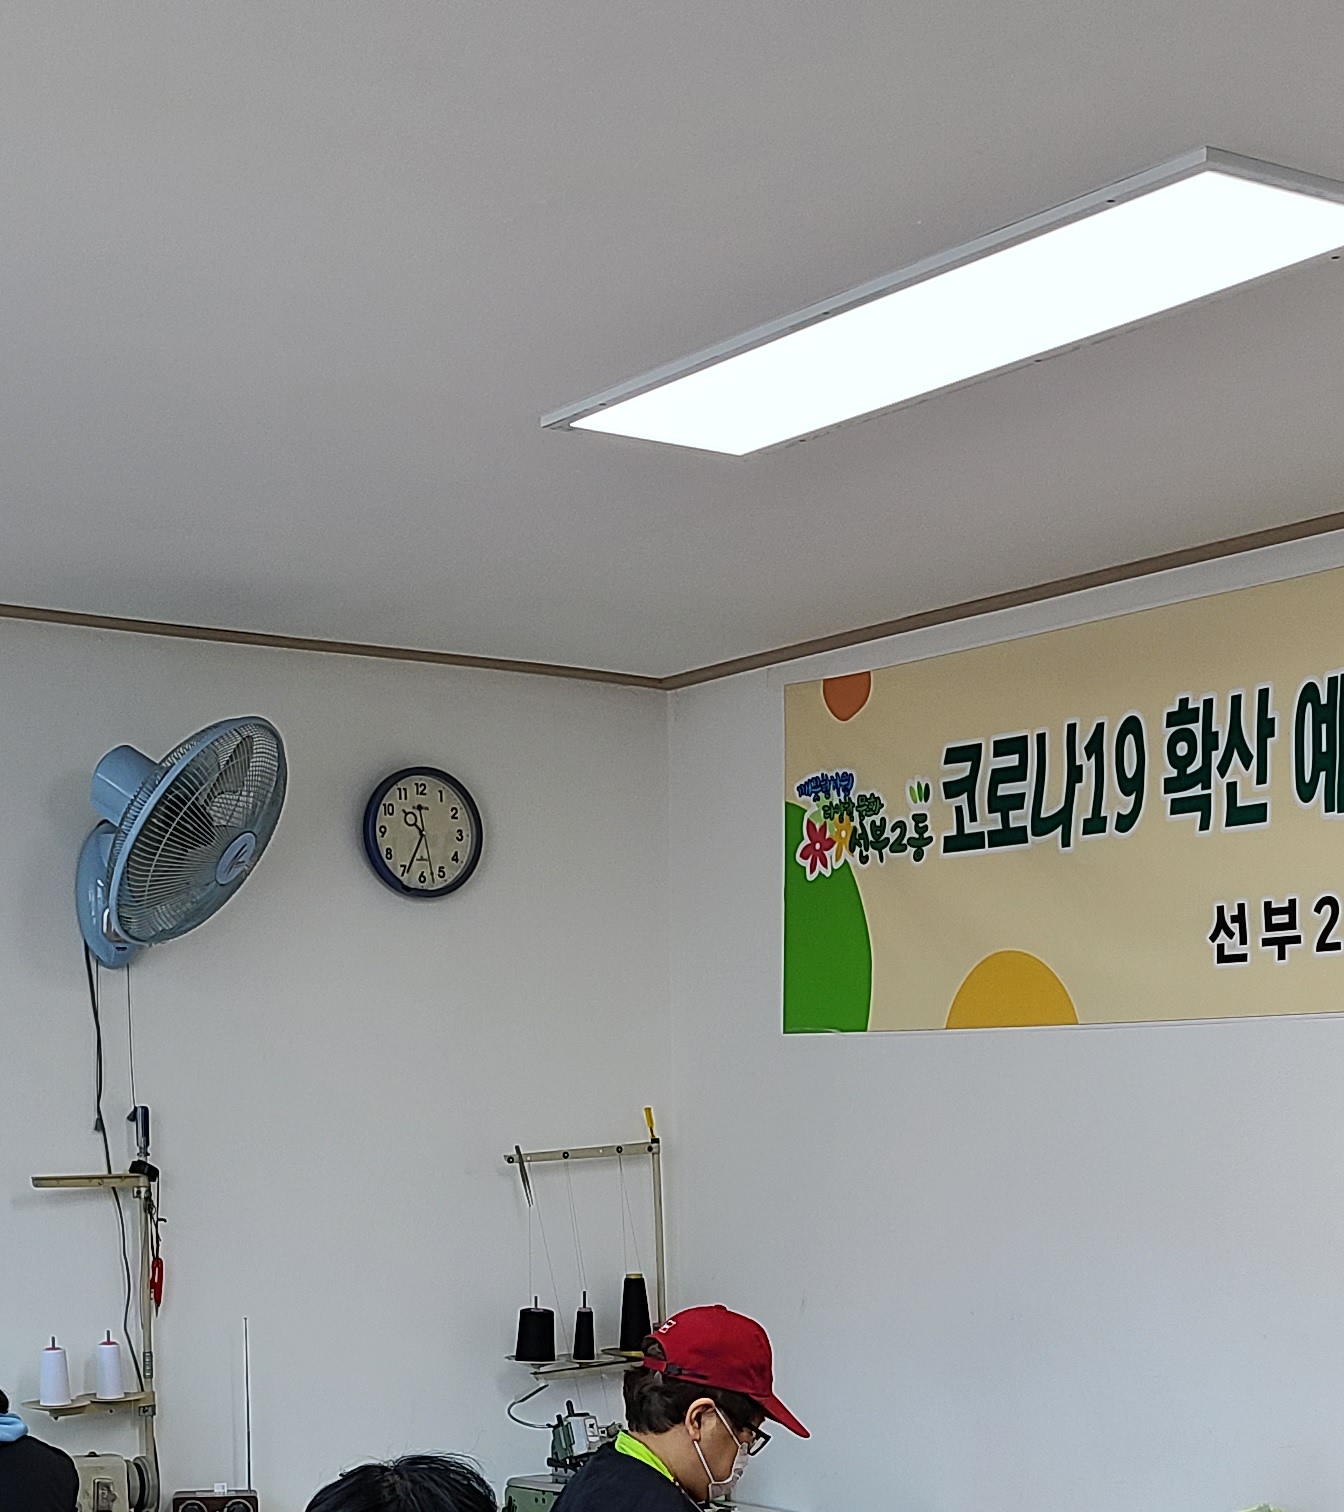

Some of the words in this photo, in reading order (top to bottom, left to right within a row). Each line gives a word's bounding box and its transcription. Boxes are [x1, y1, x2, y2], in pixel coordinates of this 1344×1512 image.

[942, 715, 1146, 854] 코로나19
[1163, 687, 1276, 832] 확산
[397, 788, 408, 801] 11
[415, 783, 427, 796] 12
[438, 790, 444, 803] 1
[382, 803, 395, 816] 10
[450, 807, 459, 820] 2
[379, 825, 387, 838] 9
[456, 829, 464, 842] 3
[849, 812, 933, 865] 선부2동
[385, 847, 393, 860] 8
[451, 850, 460, 864] 4
[400, 864, 407, 878] 7
[418, 871, 427, 884] 6
[437, 866, 446, 879] 5
